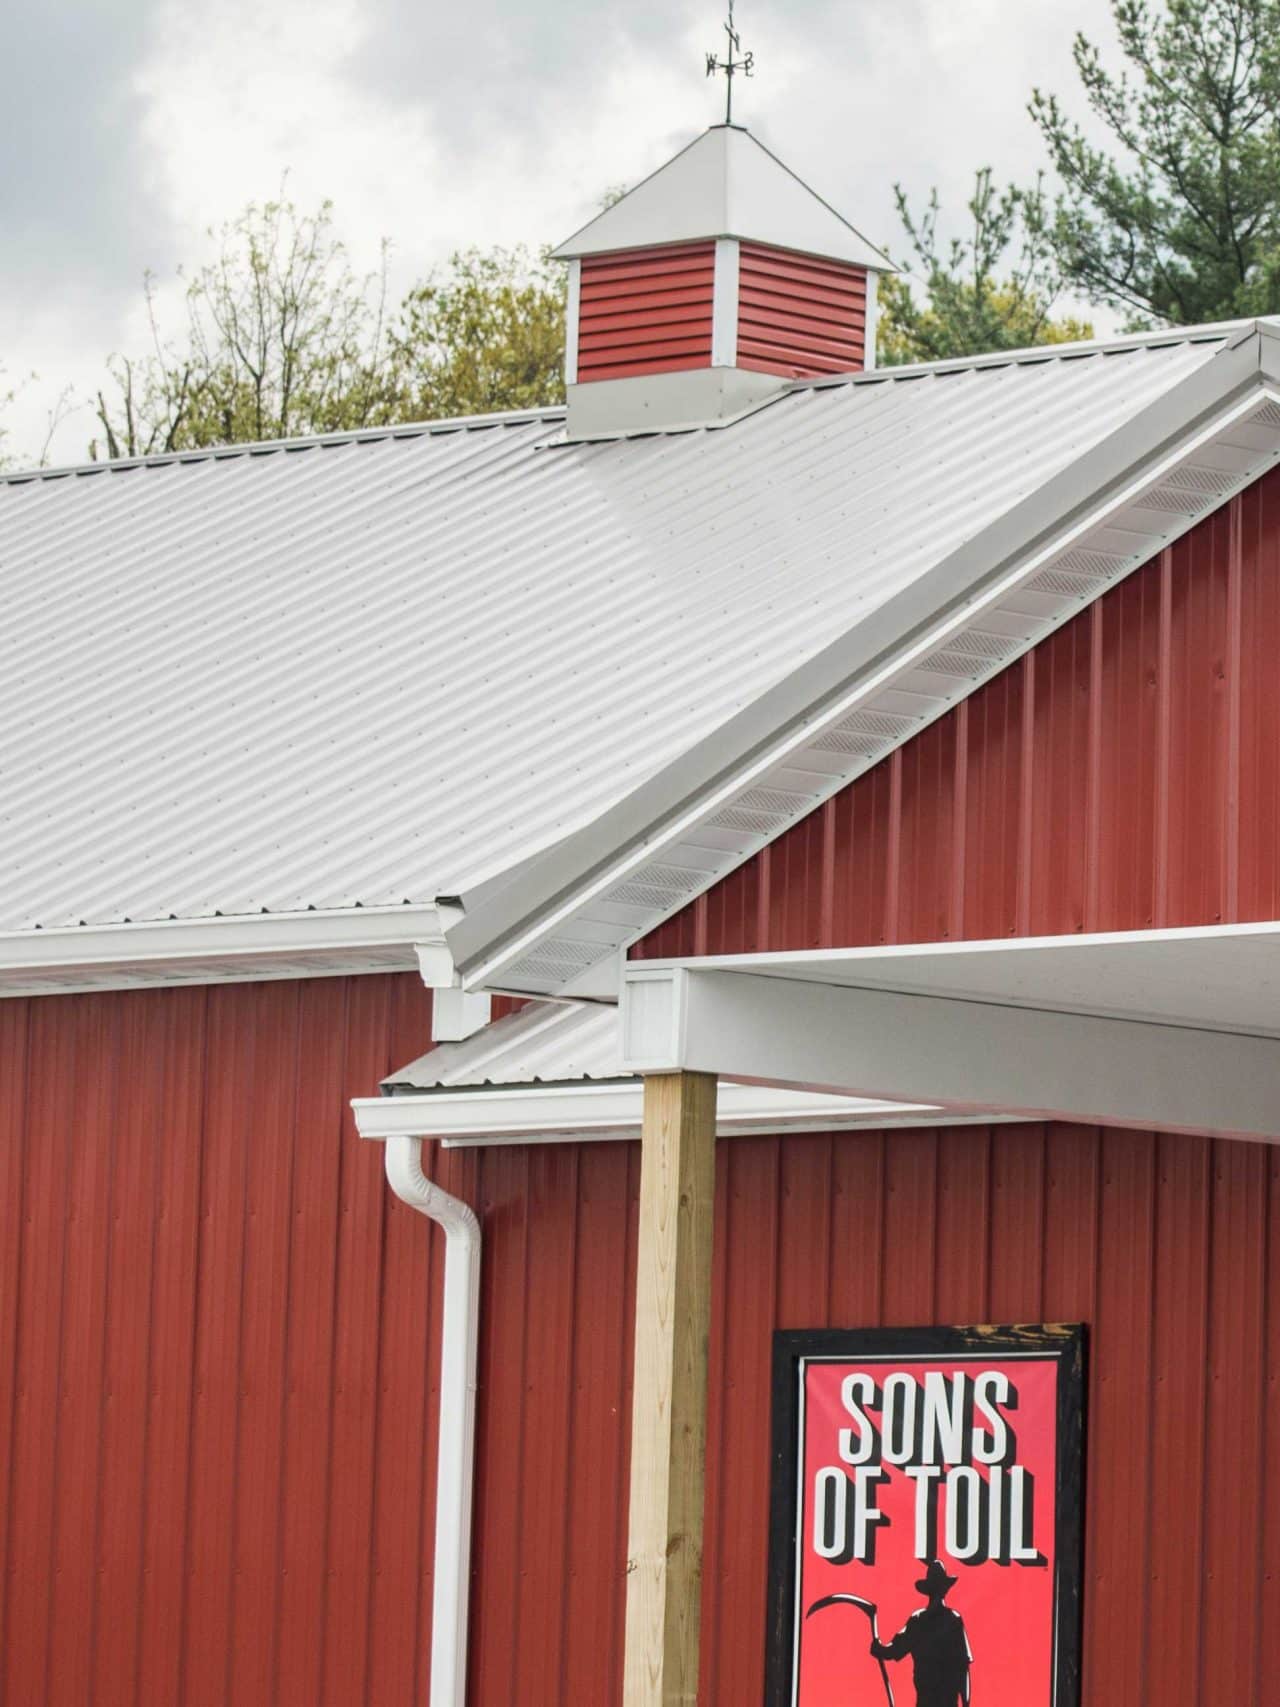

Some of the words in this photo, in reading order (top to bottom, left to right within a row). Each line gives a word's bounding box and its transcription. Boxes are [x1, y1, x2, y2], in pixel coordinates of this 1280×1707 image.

[838, 1371, 1010, 1465] SONS
[813, 1465, 882, 1559] OF
[904, 1465, 1038, 1560] TOIL
